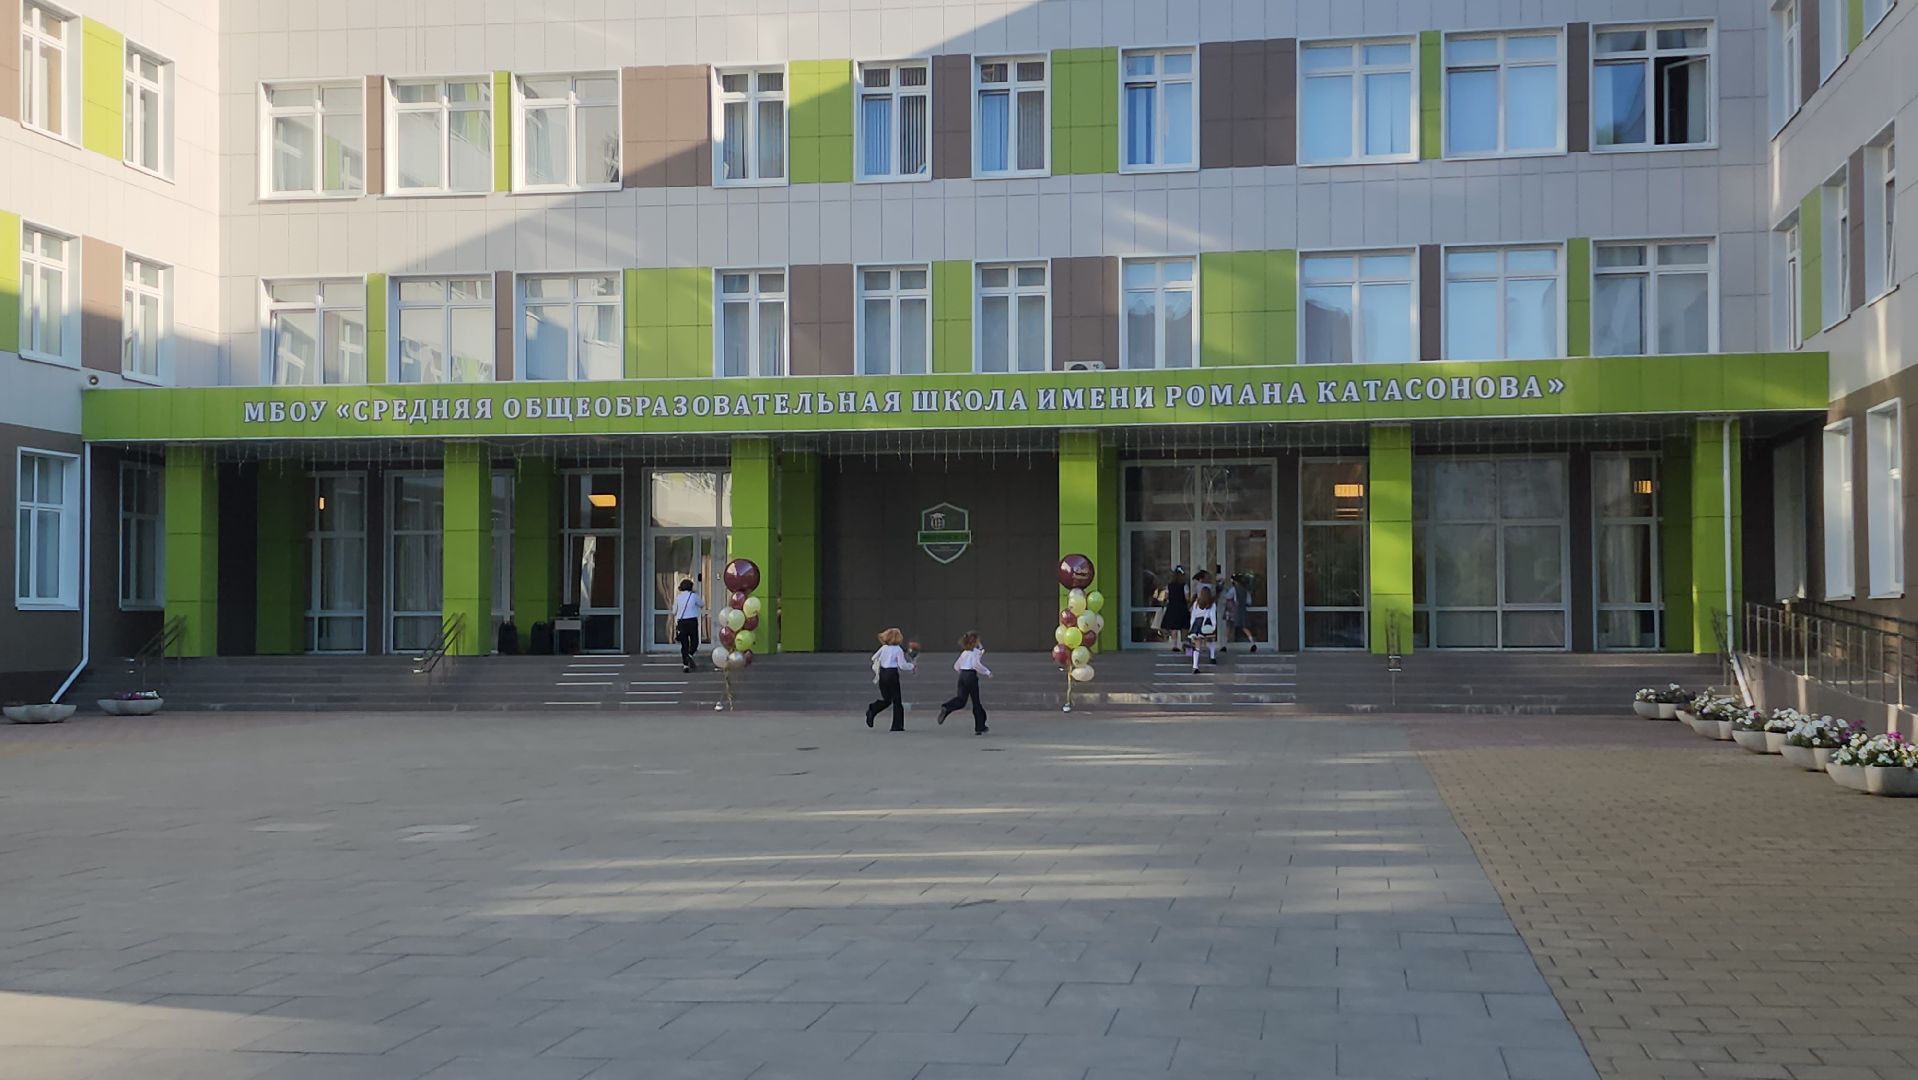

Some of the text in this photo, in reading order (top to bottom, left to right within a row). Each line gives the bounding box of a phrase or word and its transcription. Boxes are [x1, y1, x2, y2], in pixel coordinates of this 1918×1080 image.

[243, 375, 1565, 425] МБОУ «СРЕДНЯЯ ОБЩЕОБРАЗОВАТЕЛЬНАЯ ШКОЛА ИМЕНИ РОМАНА КАТАСОНОВА»
